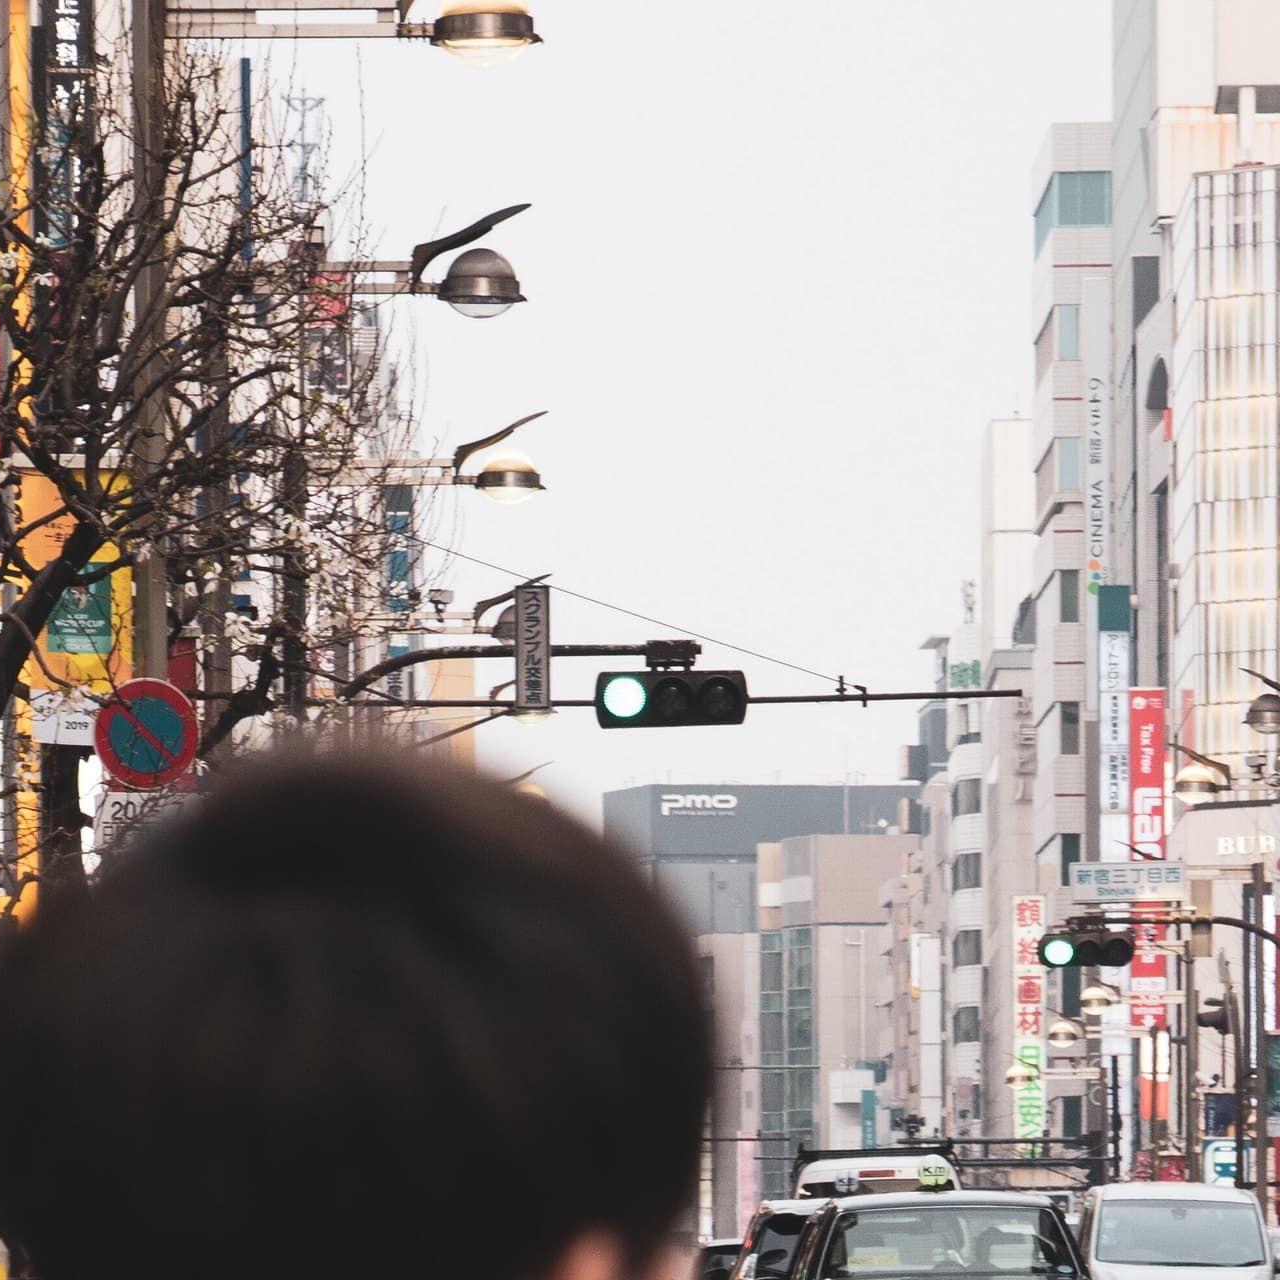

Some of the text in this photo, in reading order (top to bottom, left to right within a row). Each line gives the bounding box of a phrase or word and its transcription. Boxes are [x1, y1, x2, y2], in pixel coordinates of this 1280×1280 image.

[1090, 479, 1104, 558] CINEMA
[524, 591, 542, 704] スクランブル交差点
[65, 721, 89, 731] 2019
[1140, 723, 1155, 746] Tax
[1076, 867, 1181, 884] 新宿三丁目西
